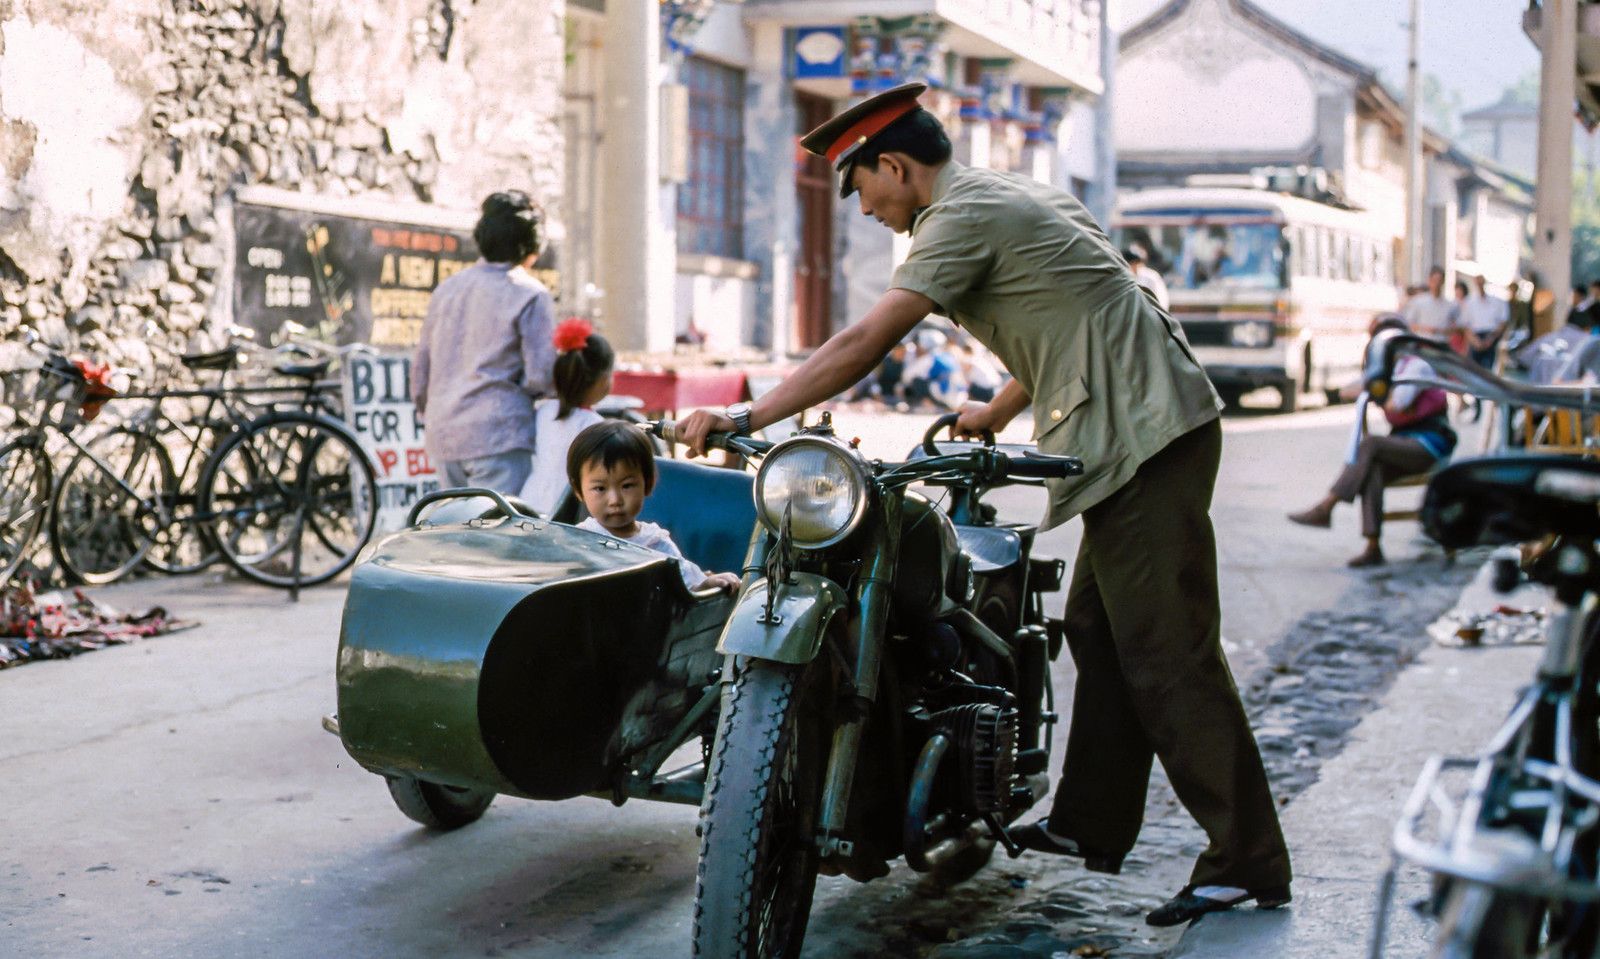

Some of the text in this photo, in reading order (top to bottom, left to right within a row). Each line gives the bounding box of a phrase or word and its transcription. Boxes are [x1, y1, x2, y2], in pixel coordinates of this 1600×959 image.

[380, 253, 396, 285] A
[399, 255, 435, 288] NEW
[355, 410, 402, 442] FOR
